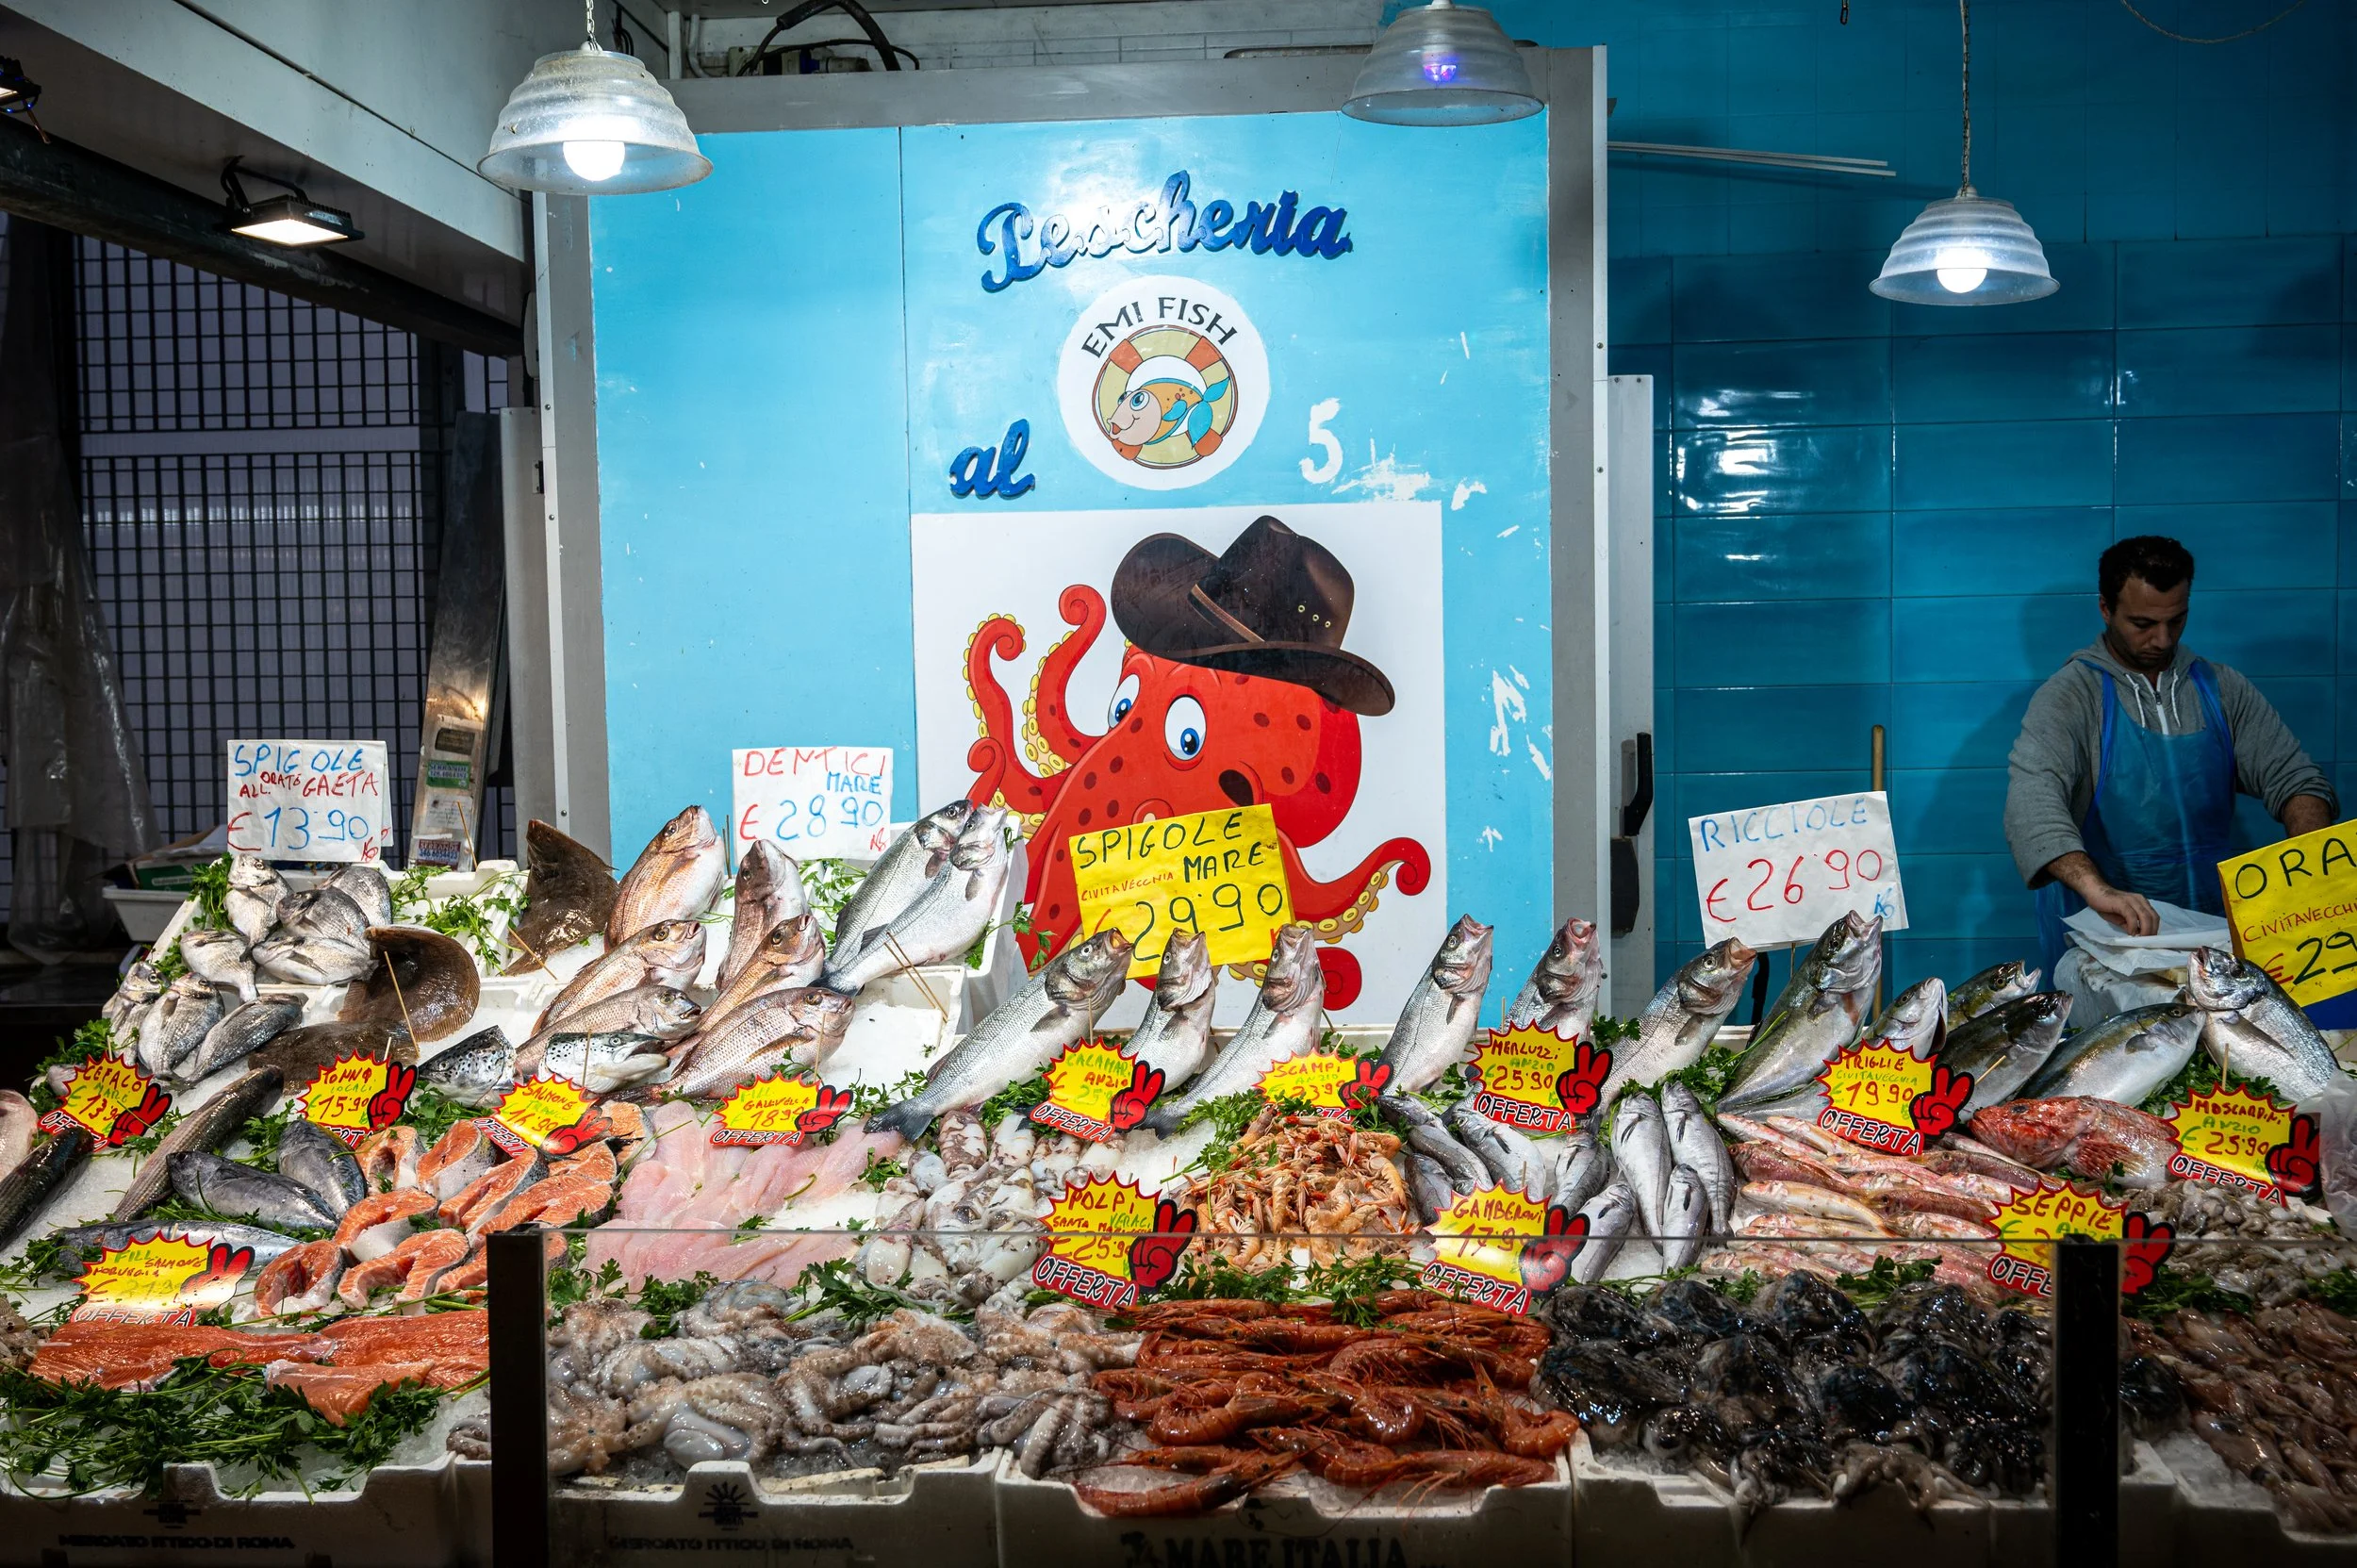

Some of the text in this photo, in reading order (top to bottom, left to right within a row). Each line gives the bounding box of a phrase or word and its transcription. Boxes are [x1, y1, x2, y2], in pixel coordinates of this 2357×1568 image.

[977, 170, 1353, 292] Pescheria
[1081, 296, 1239, 359] EMI FISH
[948, 398, 1343, 499] al 5
[234, 744, 364, 777] SPIGOLE
[744, 746, 886, 778] DENTICI
[303, 769, 379, 798] GAETA
[826, 770, 882, 796] MARE
[1077, 811, 1244, 869] SPIGOLE
[1700, 799, 1868, 852] RICCIOLE
[1183, 841, 1265, 883] MARE
[2234, 834, 2357, 900] ORA
[82, 1065, 142, 1092] CEFALO
[1842, 1053, 1905, 1072] TRIGLIE
[522, 1081, 578, 1111] SALMONE
[1476, 1094, 1573, 1131] OFFERTA
[713, 1129, 802, 1145] OFFERTA
[1033, 1103, 1113, 1141] OFFERTA
[1821, 1109, 1921, 1156] OFFERTA
[2172, 1155, 2282, 1204] OFFERTA
[1052, 1215, 1089, 1229] SANTA
[2011, 1194, 2120, 1231] SEPPIE
[1036, 1255, 1137, 1307] OFFERTA
[1422, 1262, 1528, 1313] OFFERTA
[1991, 1256, 2053, 1296] OFFE
[74, 1308, 192, 1328] OFFERTA
[237, 1536, 296, 1549] ROMA
[1282, 1537, 1409, 1568] ITALIA
